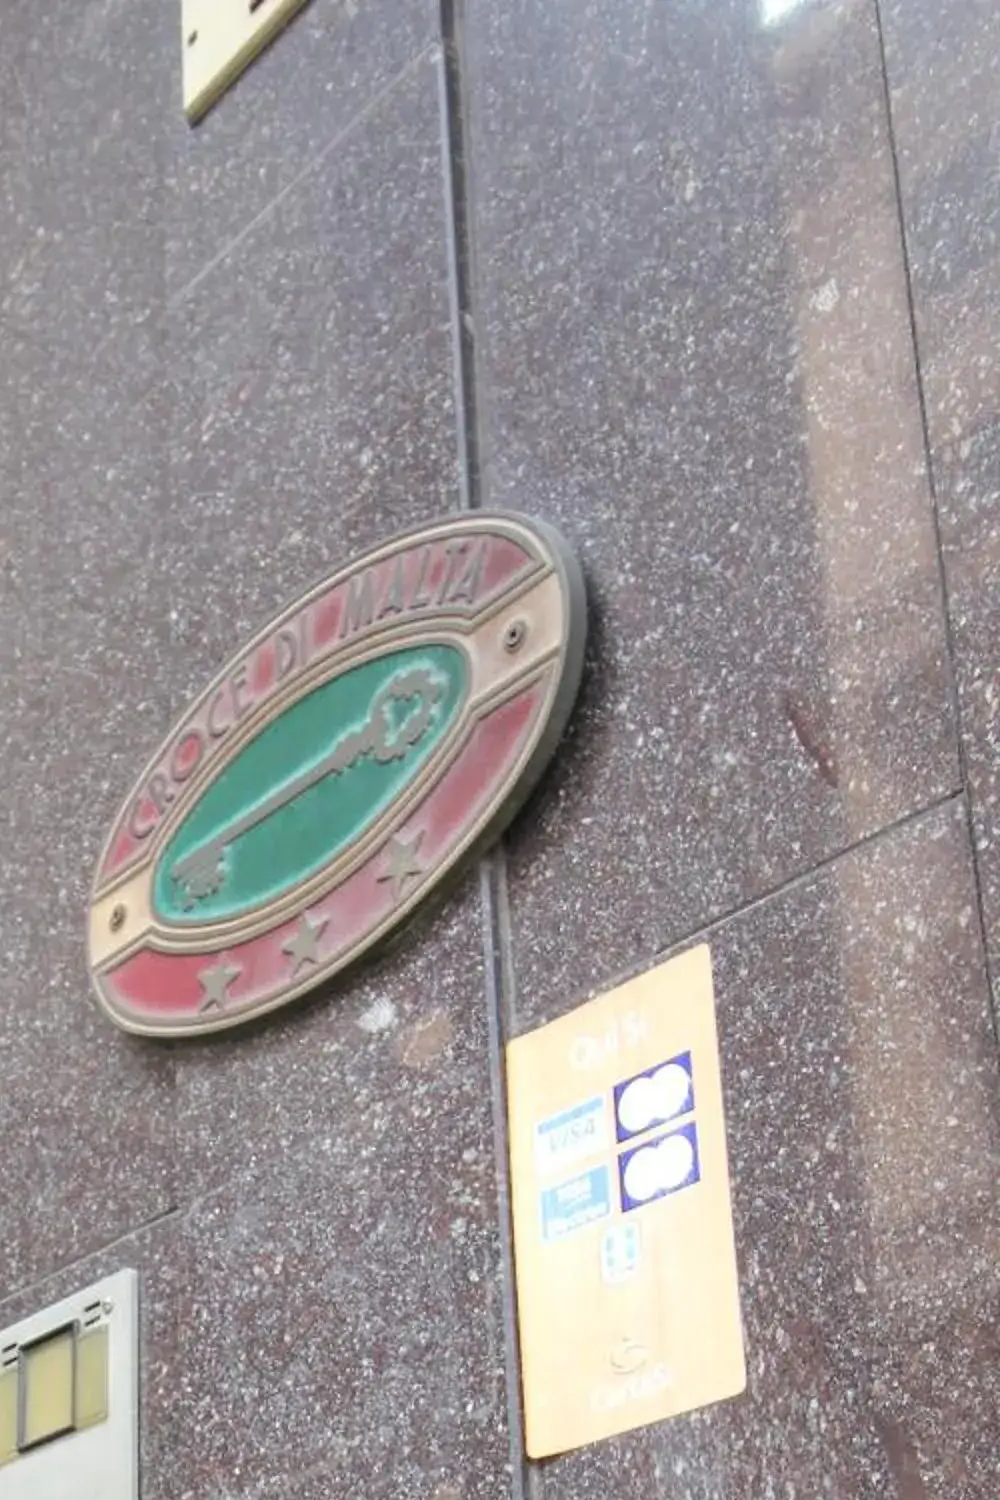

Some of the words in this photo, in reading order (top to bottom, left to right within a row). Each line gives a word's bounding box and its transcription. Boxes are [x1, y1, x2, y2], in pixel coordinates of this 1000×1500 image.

[127, 665, 248, 840] CROCE
[273, 613, 309, 676] DI
[338, 537, 488, 640] MALTA
[549, 1117, 596, 1153] VISA
